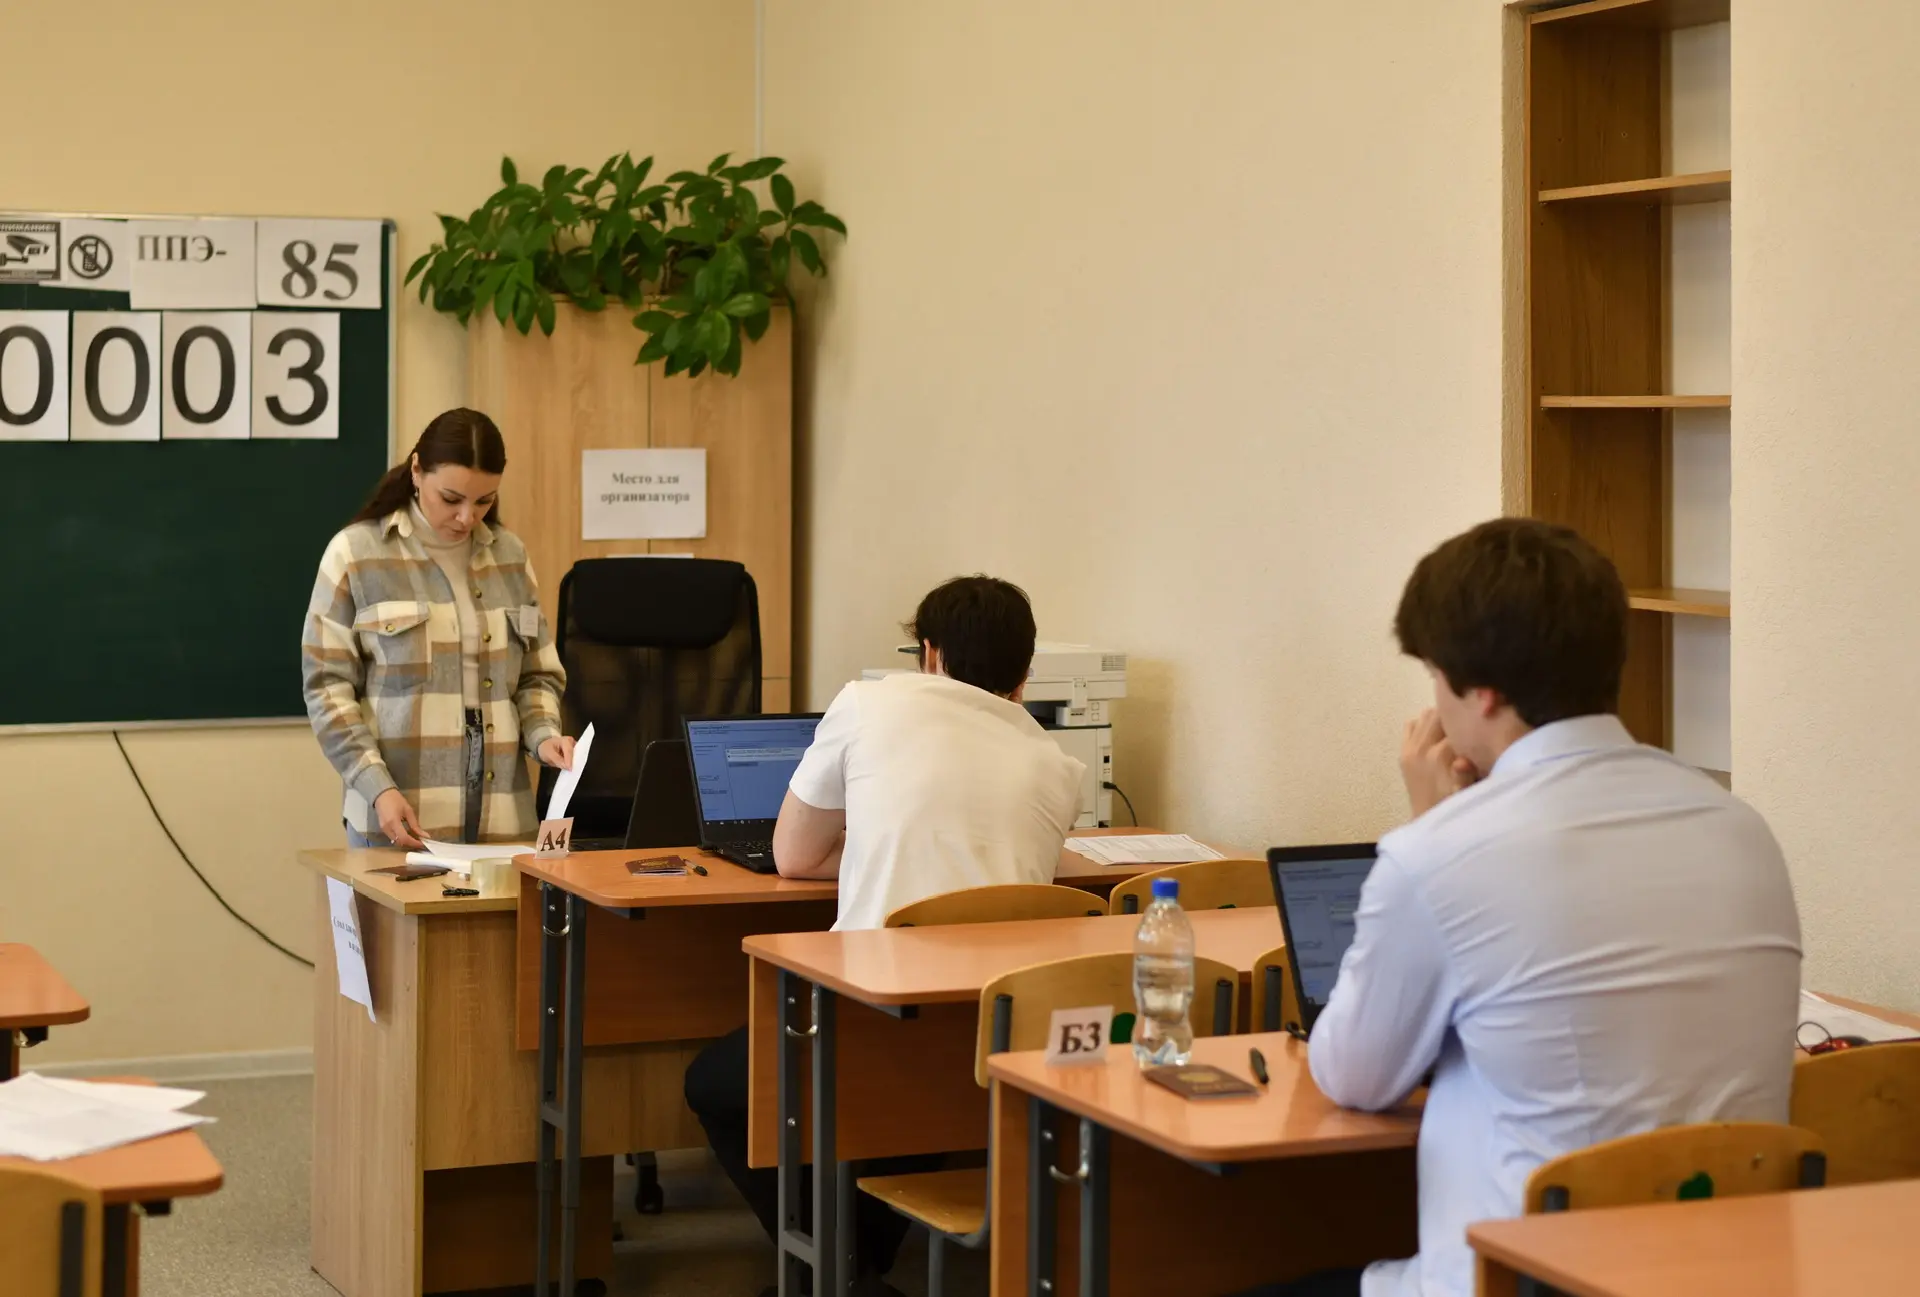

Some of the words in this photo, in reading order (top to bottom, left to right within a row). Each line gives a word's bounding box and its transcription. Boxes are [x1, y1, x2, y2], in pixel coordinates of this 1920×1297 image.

[137, 235, 227, 262] ППЭ-
[281, 239, 360, 300] 85
[612, 472, 652, 485] Место
[656, 474, 679, 485] для
[601, 491, 690, 505] организатора
[540, 827, 567, 852] А4
[1058, 1021, 1102, 1055] Б3
